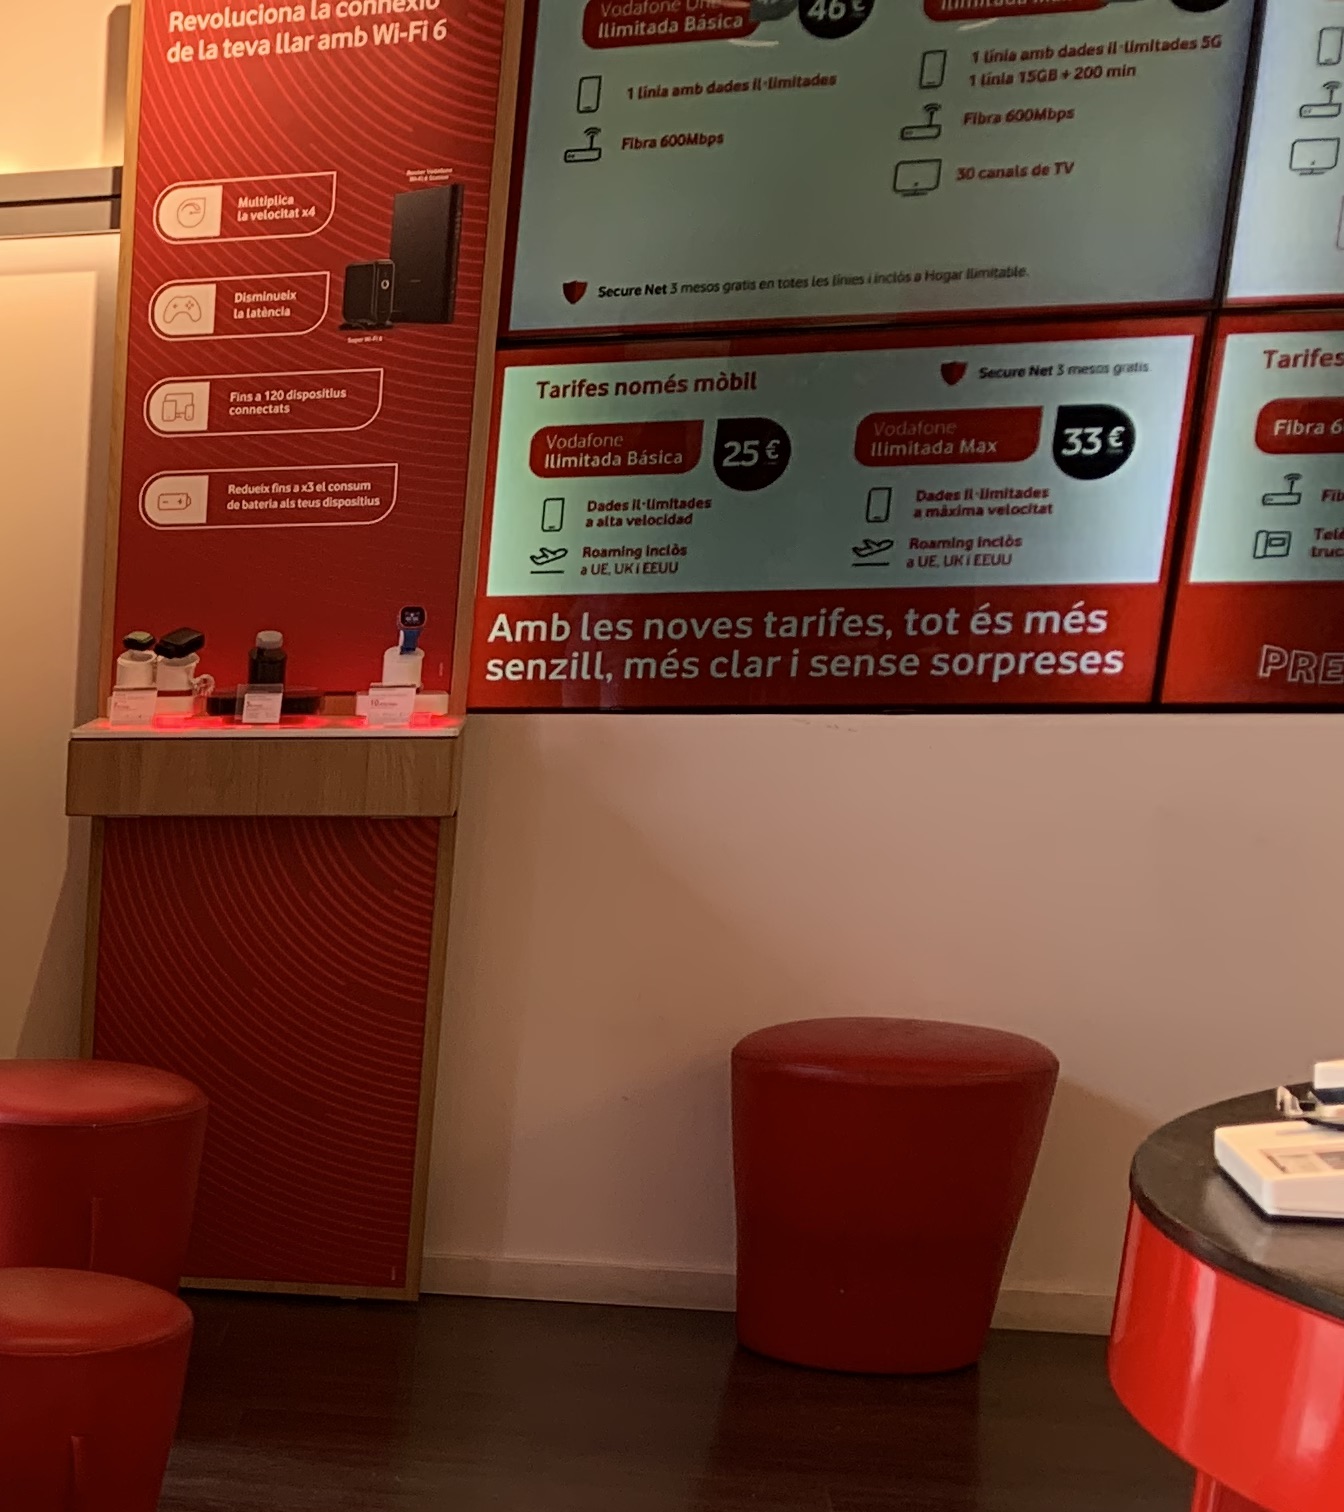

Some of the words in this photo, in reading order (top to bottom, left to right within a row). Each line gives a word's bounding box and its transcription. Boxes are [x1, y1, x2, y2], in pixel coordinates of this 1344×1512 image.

[169, 5, 305, 33] Revoluciona
[311, 0, 331, 20] la
[601, 0, 681, 17] Vodafone
[807, 0, 846, 20] 46
[598, 17, 679, 38] Ilimitada
[684, 13, 743, 32] Básica
[167, 41, 194, 64] de
[198, 39, 218, 61] la
[222, 38, 270, 59] teva
[276, 33, 314, 54] llar
[318, 26, 368, 50] amb
[373, 20, 429, 46] Wi-Fi
[433, 18, 448, 41] 6
[972, 50, 979, 64] 1
[984, 46, 1016, 63] línia
[1020, 45, 1055, 61] amb
[1057, 42, 1104, 59] dades
[1200, 34, 1222, 50] 5G
[969, 74, 976, 87] 1
[981, 69, 1014, 87] línia
[1019, 68, 1058, 84] 15GB
[1062, 71, 1070, 81] +
[1073, 66, 1103, 81] 200
[1106, 63, 1137, 79] min
[627, 88, 633, 99] 1
[638, 84, 668, 99] línia
[672, 81, 703, 97] amb
[706, 79, 749, 95] dades
[963, 111, 1002, 126] Fibra
[1005, 107, 1076, 124] 600Mbps
[621, 134, 657, 150] Fibra
[660, 132, 725, 147] 600Mbps
[956, 166, 975, 181] 30
[978, 165, 1029, 180] canals
[1031, 163, 1050, 177] de
[1054, 161, 1075, 175] TV
[237, 194, 295, 209] Multiplica
[237, 210, 248, 222] la
[250, 207, 300, 221] velocitat
[302, 205, 316, 218] x4
[598, 285, 642, 298] Secure
[644, 283, 668, 296] Net
[669, 282, 678, 295] 3
[680, 282, 720, 293] mesos
[722, 279, 756, 294] gratis
[758, 279, 775, 290] en
[778, 277, 809, 289] totes
[811, 274, 829, 288] les
[925, 269, 963, 284] Hogar
[234, 290, 297, 304] Disminueix
[233, 308, 245, 319] la
[246, 305, 291, 319] latència
[1263, 347, 1344, 369] Tarifes
[978, 366, 1026, 380] Secure
[1028, 364, 1054, 378] Net
[1056, 363, 1065, 377] 3
[1067, 364, 1110, 376] mesos
[536, 377, 609, 400] Tarifes
[614, 374, 688, 397] només
[693, 371, 757, 393] mòbil
[230, 391, 254, 403] Fins
[255, 393, 263, 402] a
[264, 389, 285, 401] 120
[286, 388, 347, 402] dispositius
[229, 403, 290, 416] connectats
[872, 420, 958, 437] Vodafone
[1274, 418, 1325, 436] Fibra
[546, 433, 624, 450] Vodafone
[870, 440, 955, 458] Ilimitada
[958, 438, 998, 454] Max
[1062, 426, 1103, 457] 33
[1108, 424, 1126, 449] €
[544, 451, 622, 469] Ilimitada
[627, 447, 683, 467] Básica
[722, 440, 760, 468] 25
[765, 439, 781, 461] €
[228, 482, 270, 495] Redueix
[272, 482, 291, 495] fins
[292, 484, 300, 493] a
[300, 482, 314, 493] x3
[316, 481, 326, 492] el
[327, 481, 371, 492] consum
[915, 489, 962, 503] Dades
[226, 498, 240, 510] de
[241, 498, 279, 510] bateria
[279, 497, 295, 509] als
[296, 497, 321, 508] teus
[322, 495, 380, 509] dispositius
[587, 499, 629, 513] Dades
[913, 508, 922, 519] a
[987, 502, 1054, 517] velocitat
[585, 517, 593, 528] a
[596, 515, 624, 528] alta
[626, 513, 693, 527] velocidad
[582, 545, 643, 561] Roaming
[908, 537, 974, 553] Roaming
[580, 566, 588, 576] a
[614, 562, 634, 575] UK
[642, 561, 679, 575] EEUU
[906, 557, 915, 569] a
[943, 554, 964, 568] UK
[973, 553, 1012, 567] EEUU
[487, 612, 572, 644] Amb
[581, 612, 634, 642] les
[643, 614, 753, 640] noves
[763, 607, 893, 641] tarifes,
[904, 608, 960, 637] tot
[969, 602, 1014, 635] és
[1023, 600, 1109, 635] més
[485, 650, 614, 683] senzill,
[624, 647, 700, 681] més
[710, 649, 780, 680] clar
[790, 648, 800, 678] i
[808, 652, 920, 678] sense
[930, 647, 1125, 684] sorpreses
